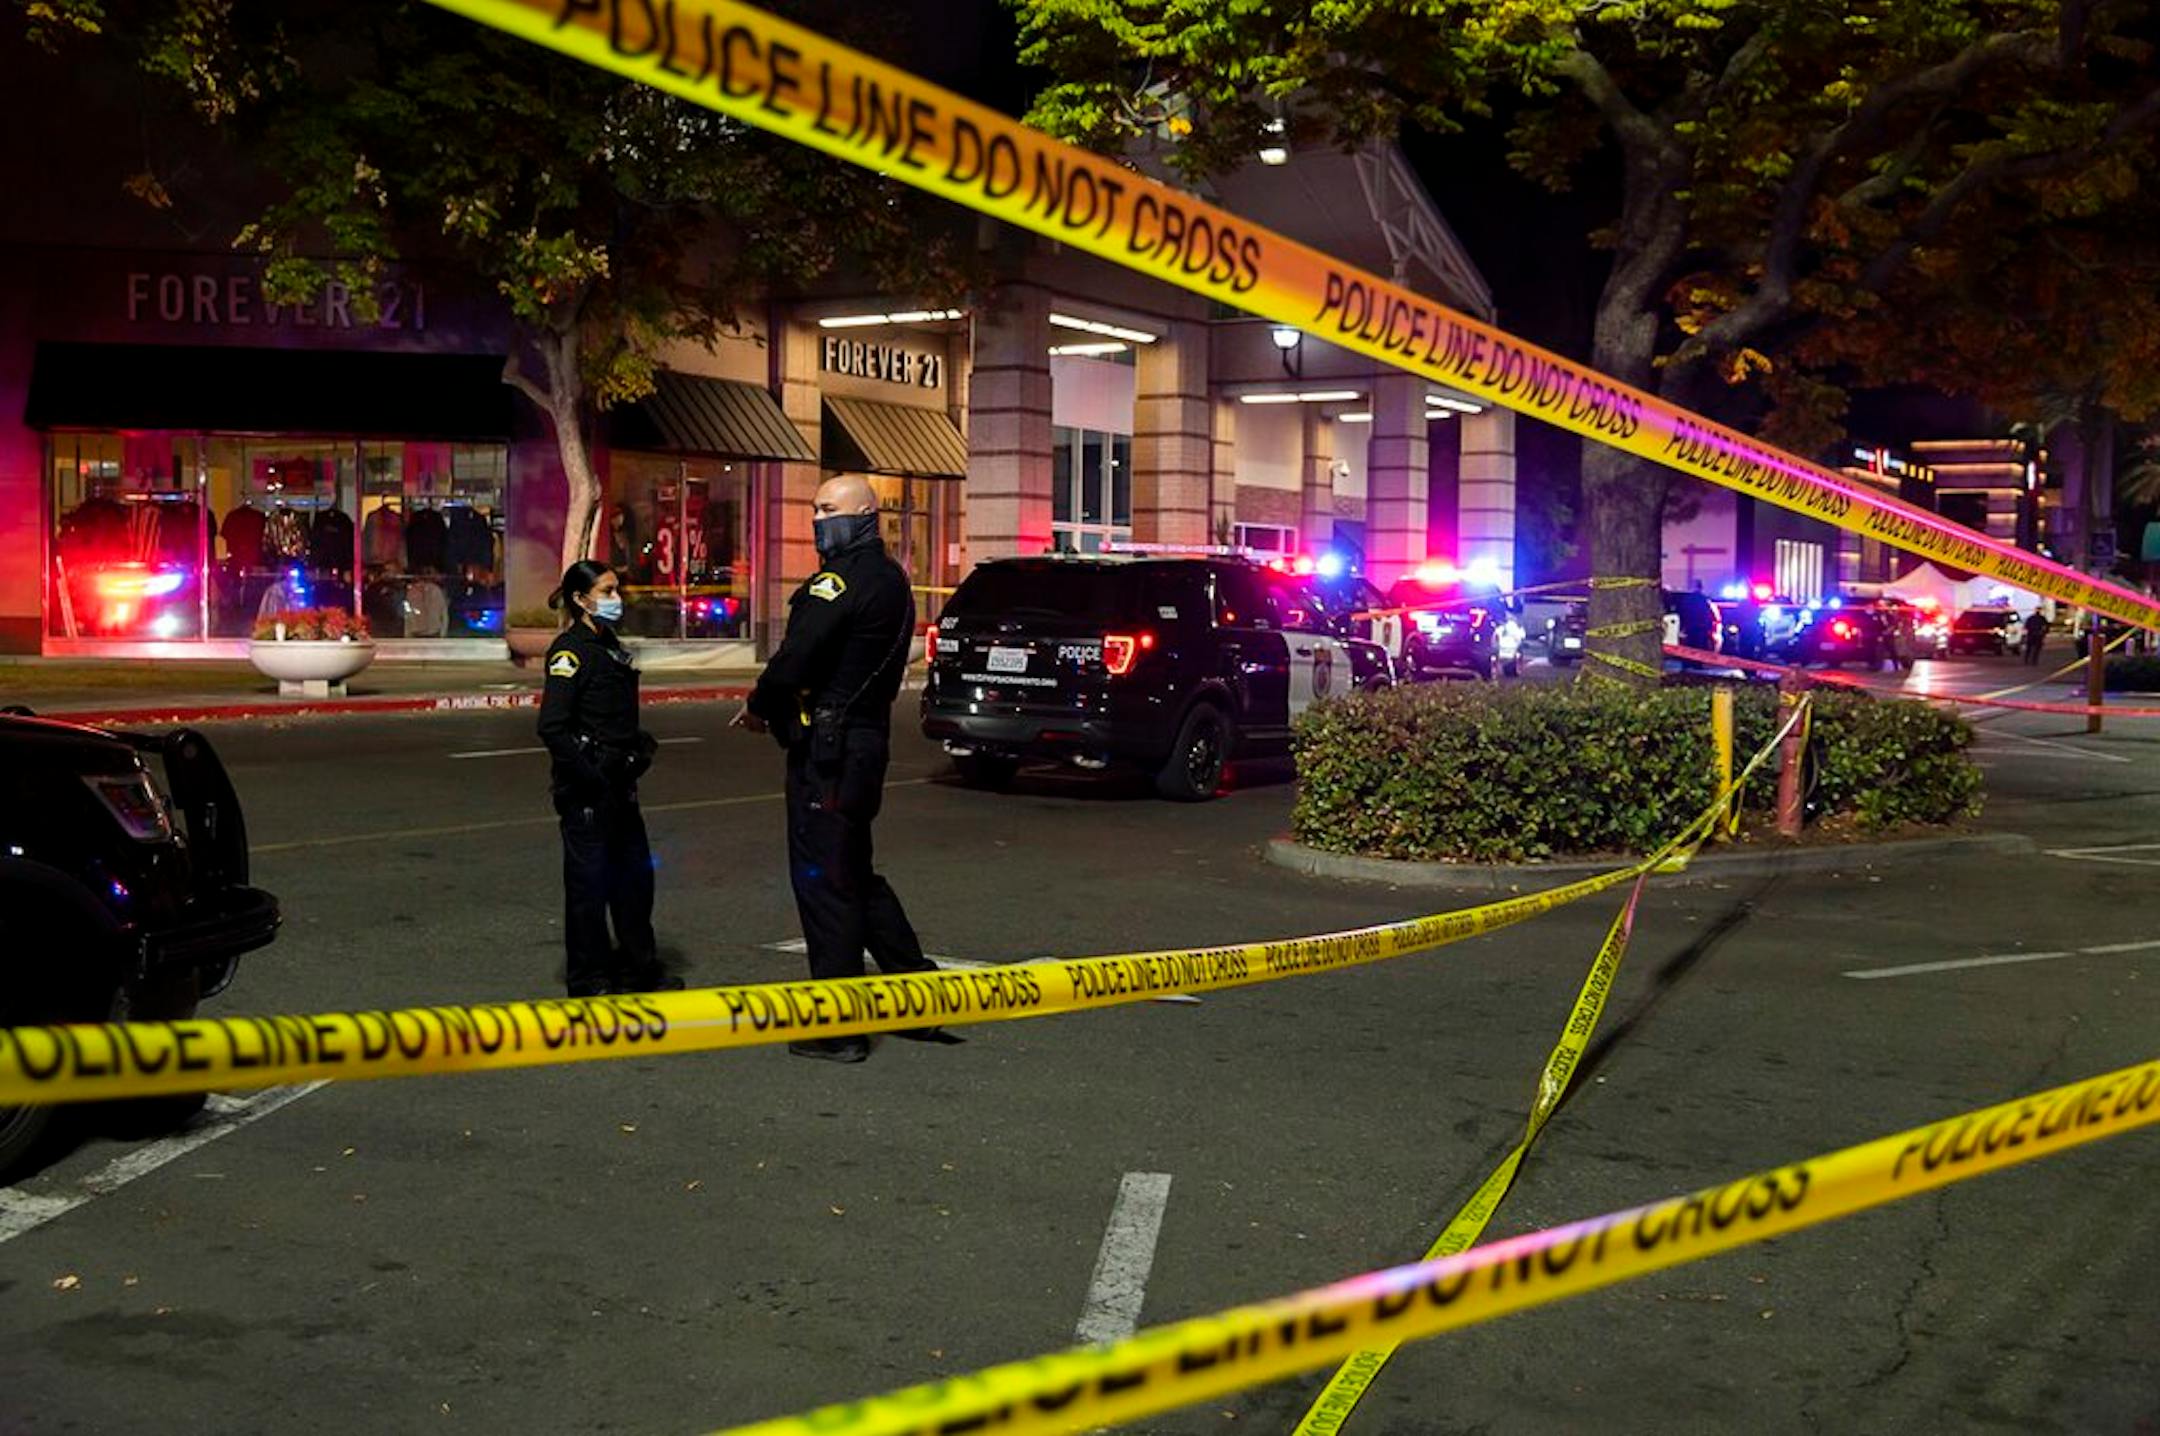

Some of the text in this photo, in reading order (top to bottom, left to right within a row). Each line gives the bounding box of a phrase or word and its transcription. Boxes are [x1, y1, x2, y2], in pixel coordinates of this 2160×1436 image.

[812, 62, 935, 169] LINE
[944, 117, 1021, 200] DO
[1024, 151, 1126, 239] NOT
[1127, 194, 1264, 294] CROSS
[825, 336, 915, 384] FOREVER
[1314, 271, 1644, 439] POLICE LINE DO NOT CROSS
[1059, 646, 1100, 661] POLICE
[718, 969, 1042, 1032] POLICE LINE DO NOT CROSS
[1065, 962, 1127, 1000] POLICE
[0, 998, 668, 1082] OLICE LINE DO NOT CROSS
